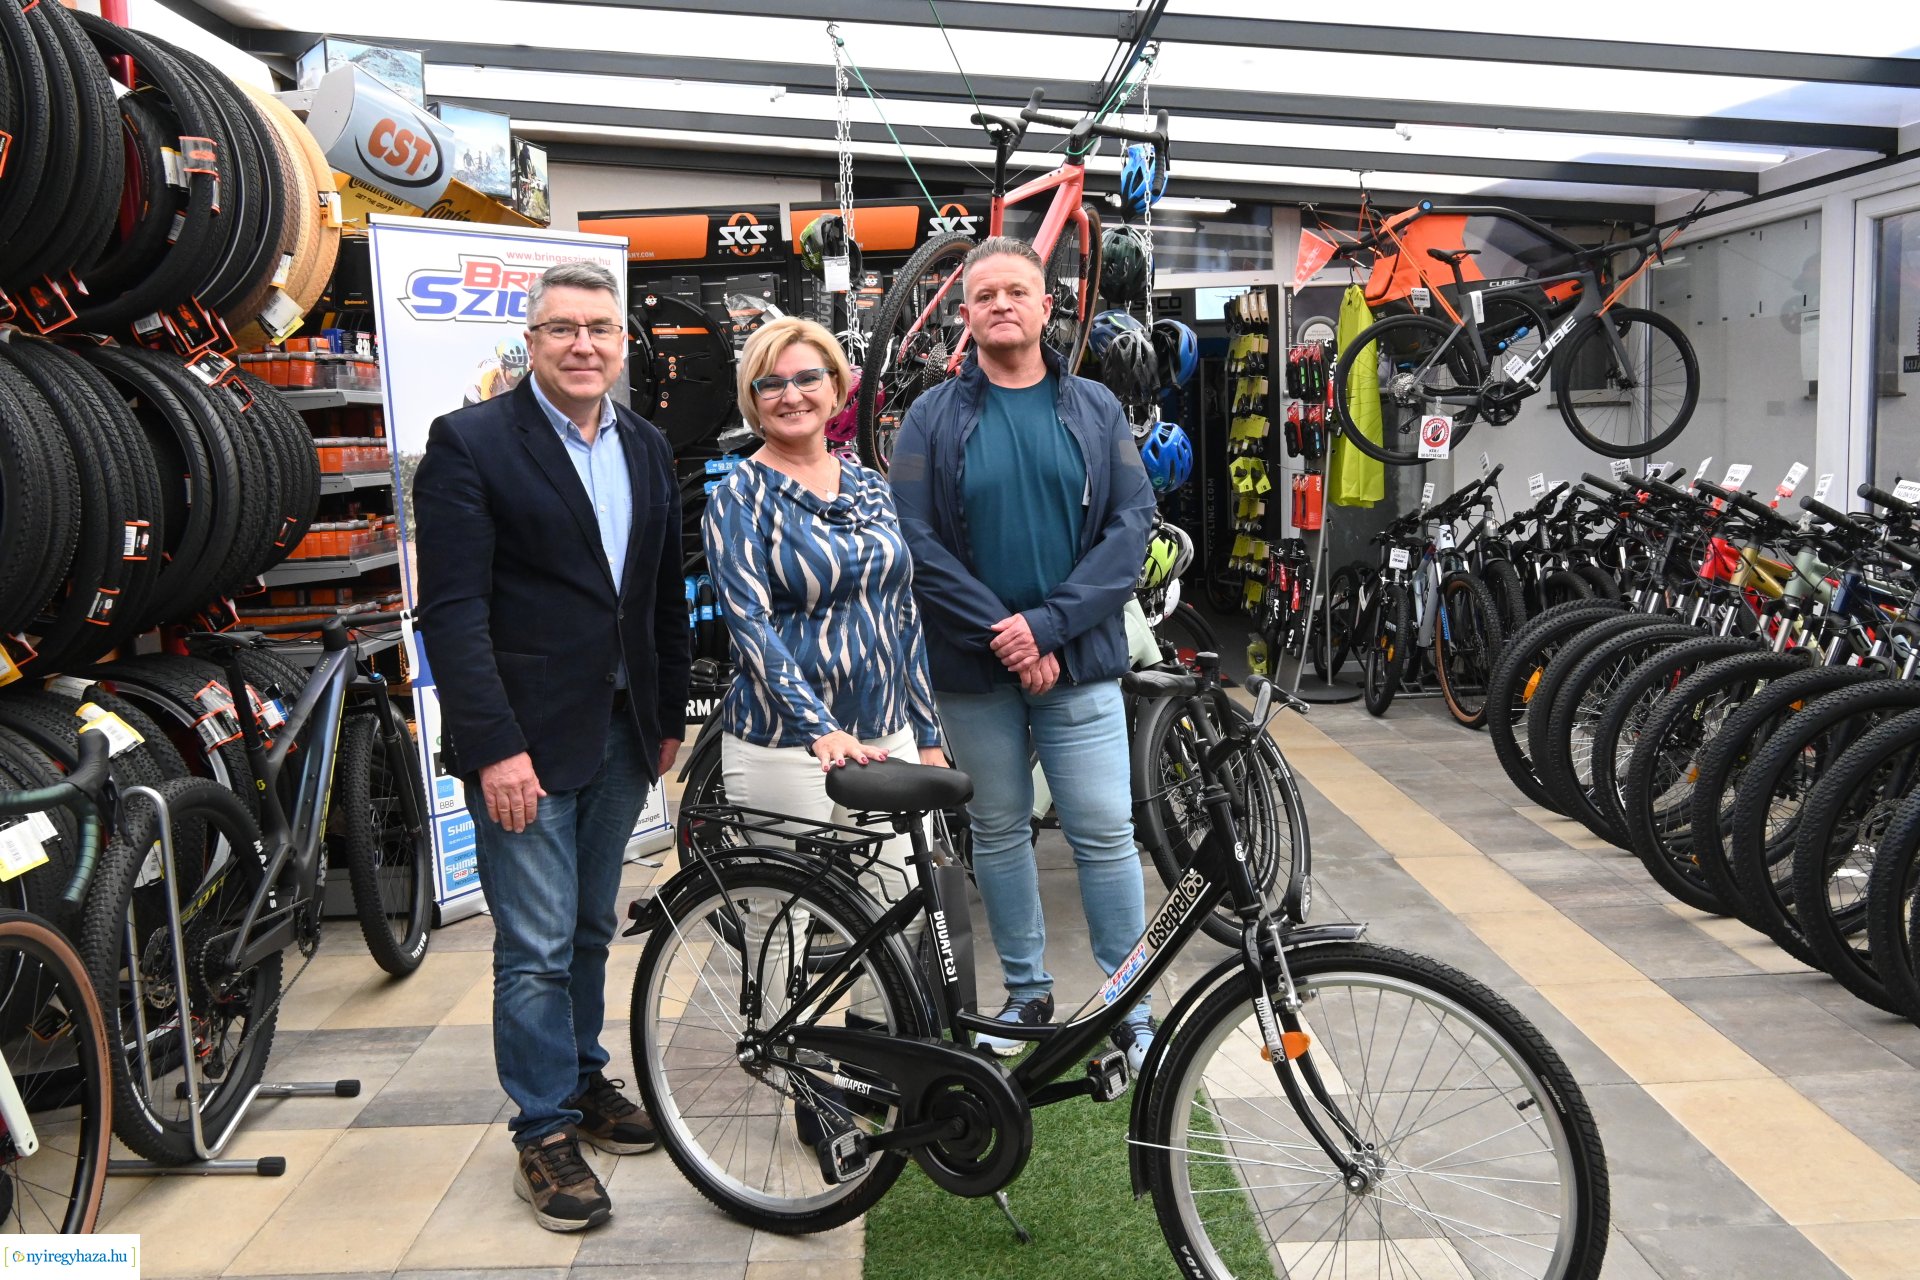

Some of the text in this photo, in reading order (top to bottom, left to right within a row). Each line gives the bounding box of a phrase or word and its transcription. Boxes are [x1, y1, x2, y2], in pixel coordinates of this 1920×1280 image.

[368, 118, 432, 176] CST
[718, 225, 768, 246] SKS
[928, 216, 978, 237] SKS
[464, 261, 544, 292] BRI
[1489, 279, 1520, 287] CUBE
[411, 275, 528, 317] SZIG
[1524, 316, 1577, 373] CUBE
[448, 821, 475, 836] SHIM
[635, 813, 661, 825] asziget
[446, 858, 477, 874] SHIMA
[1104, 951, 1147, 1005] SZIGET
[1111, 944, 1144, 985] BRINGA
[1254, 996, 1280, 1047] BUDAPEST
[833, 1073, 872, 1095] BUDAPEST
[1180, 1245, 1204, 1279] NDA
